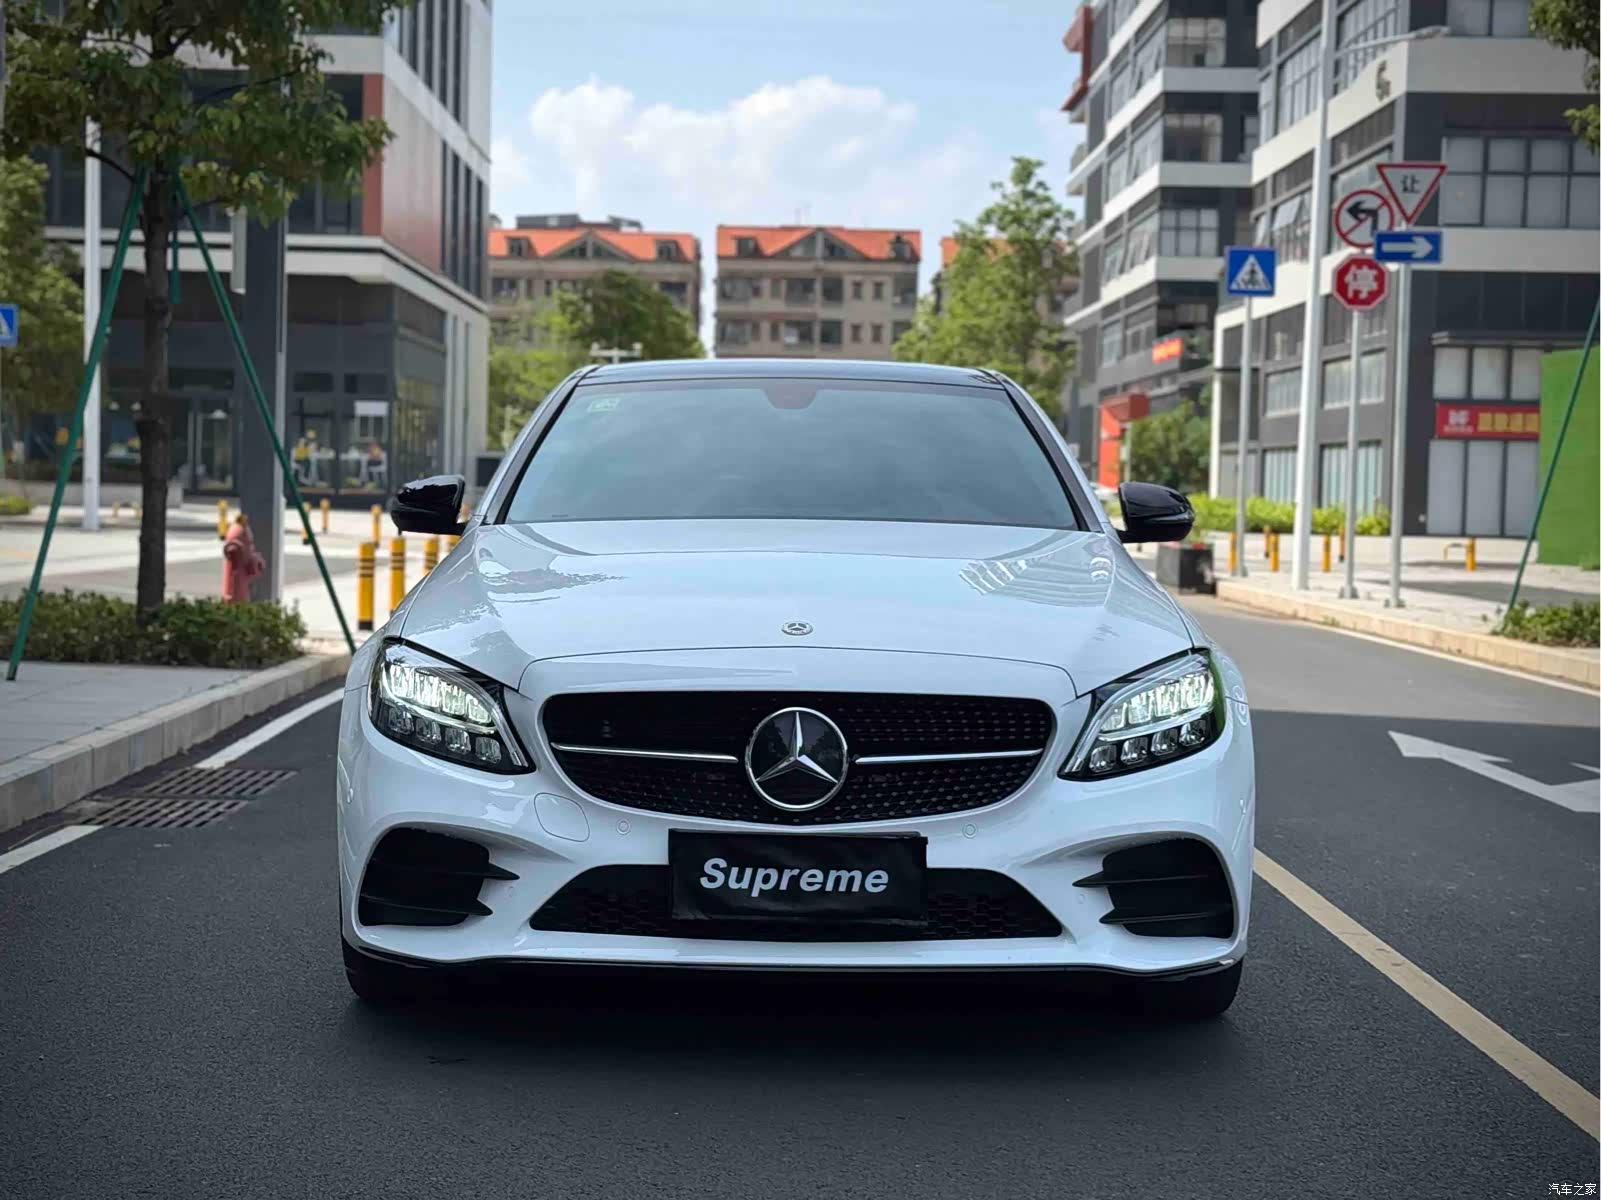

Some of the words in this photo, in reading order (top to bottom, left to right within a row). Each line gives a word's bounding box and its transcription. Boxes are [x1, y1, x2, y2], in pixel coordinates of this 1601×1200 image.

[1400, 174, 1421, 193] 让
[1344, 264, 1379, 299] 停
[699, 857, 889, 897] Supreme
